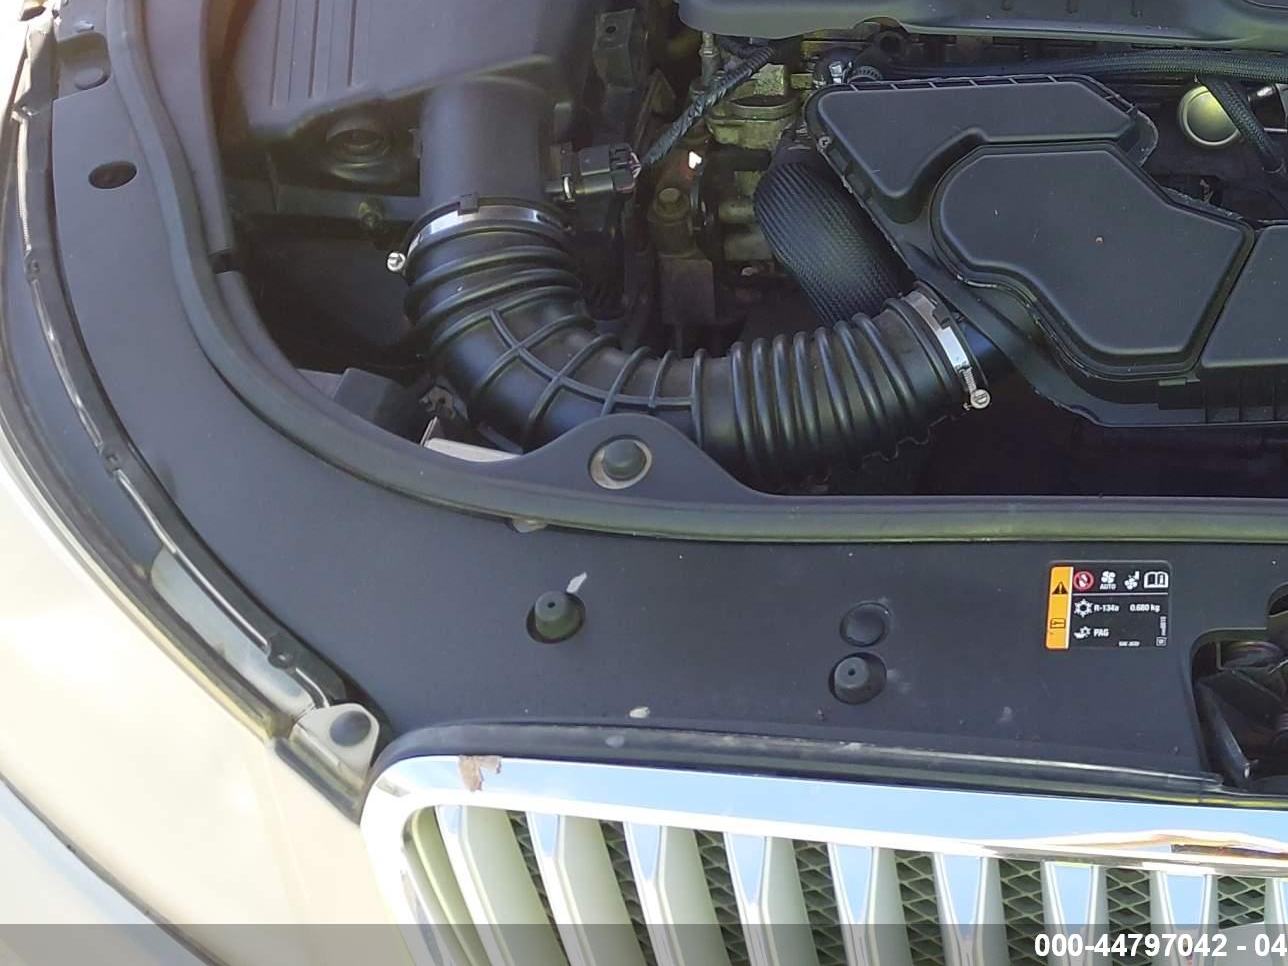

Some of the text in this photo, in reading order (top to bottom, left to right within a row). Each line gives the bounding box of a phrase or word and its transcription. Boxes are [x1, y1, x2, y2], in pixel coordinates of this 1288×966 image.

[1093, 604, 1120, 612] R-134a
[1150, 603, 1161, 613] kg
[1093, 628, 1110, 637] PAG
